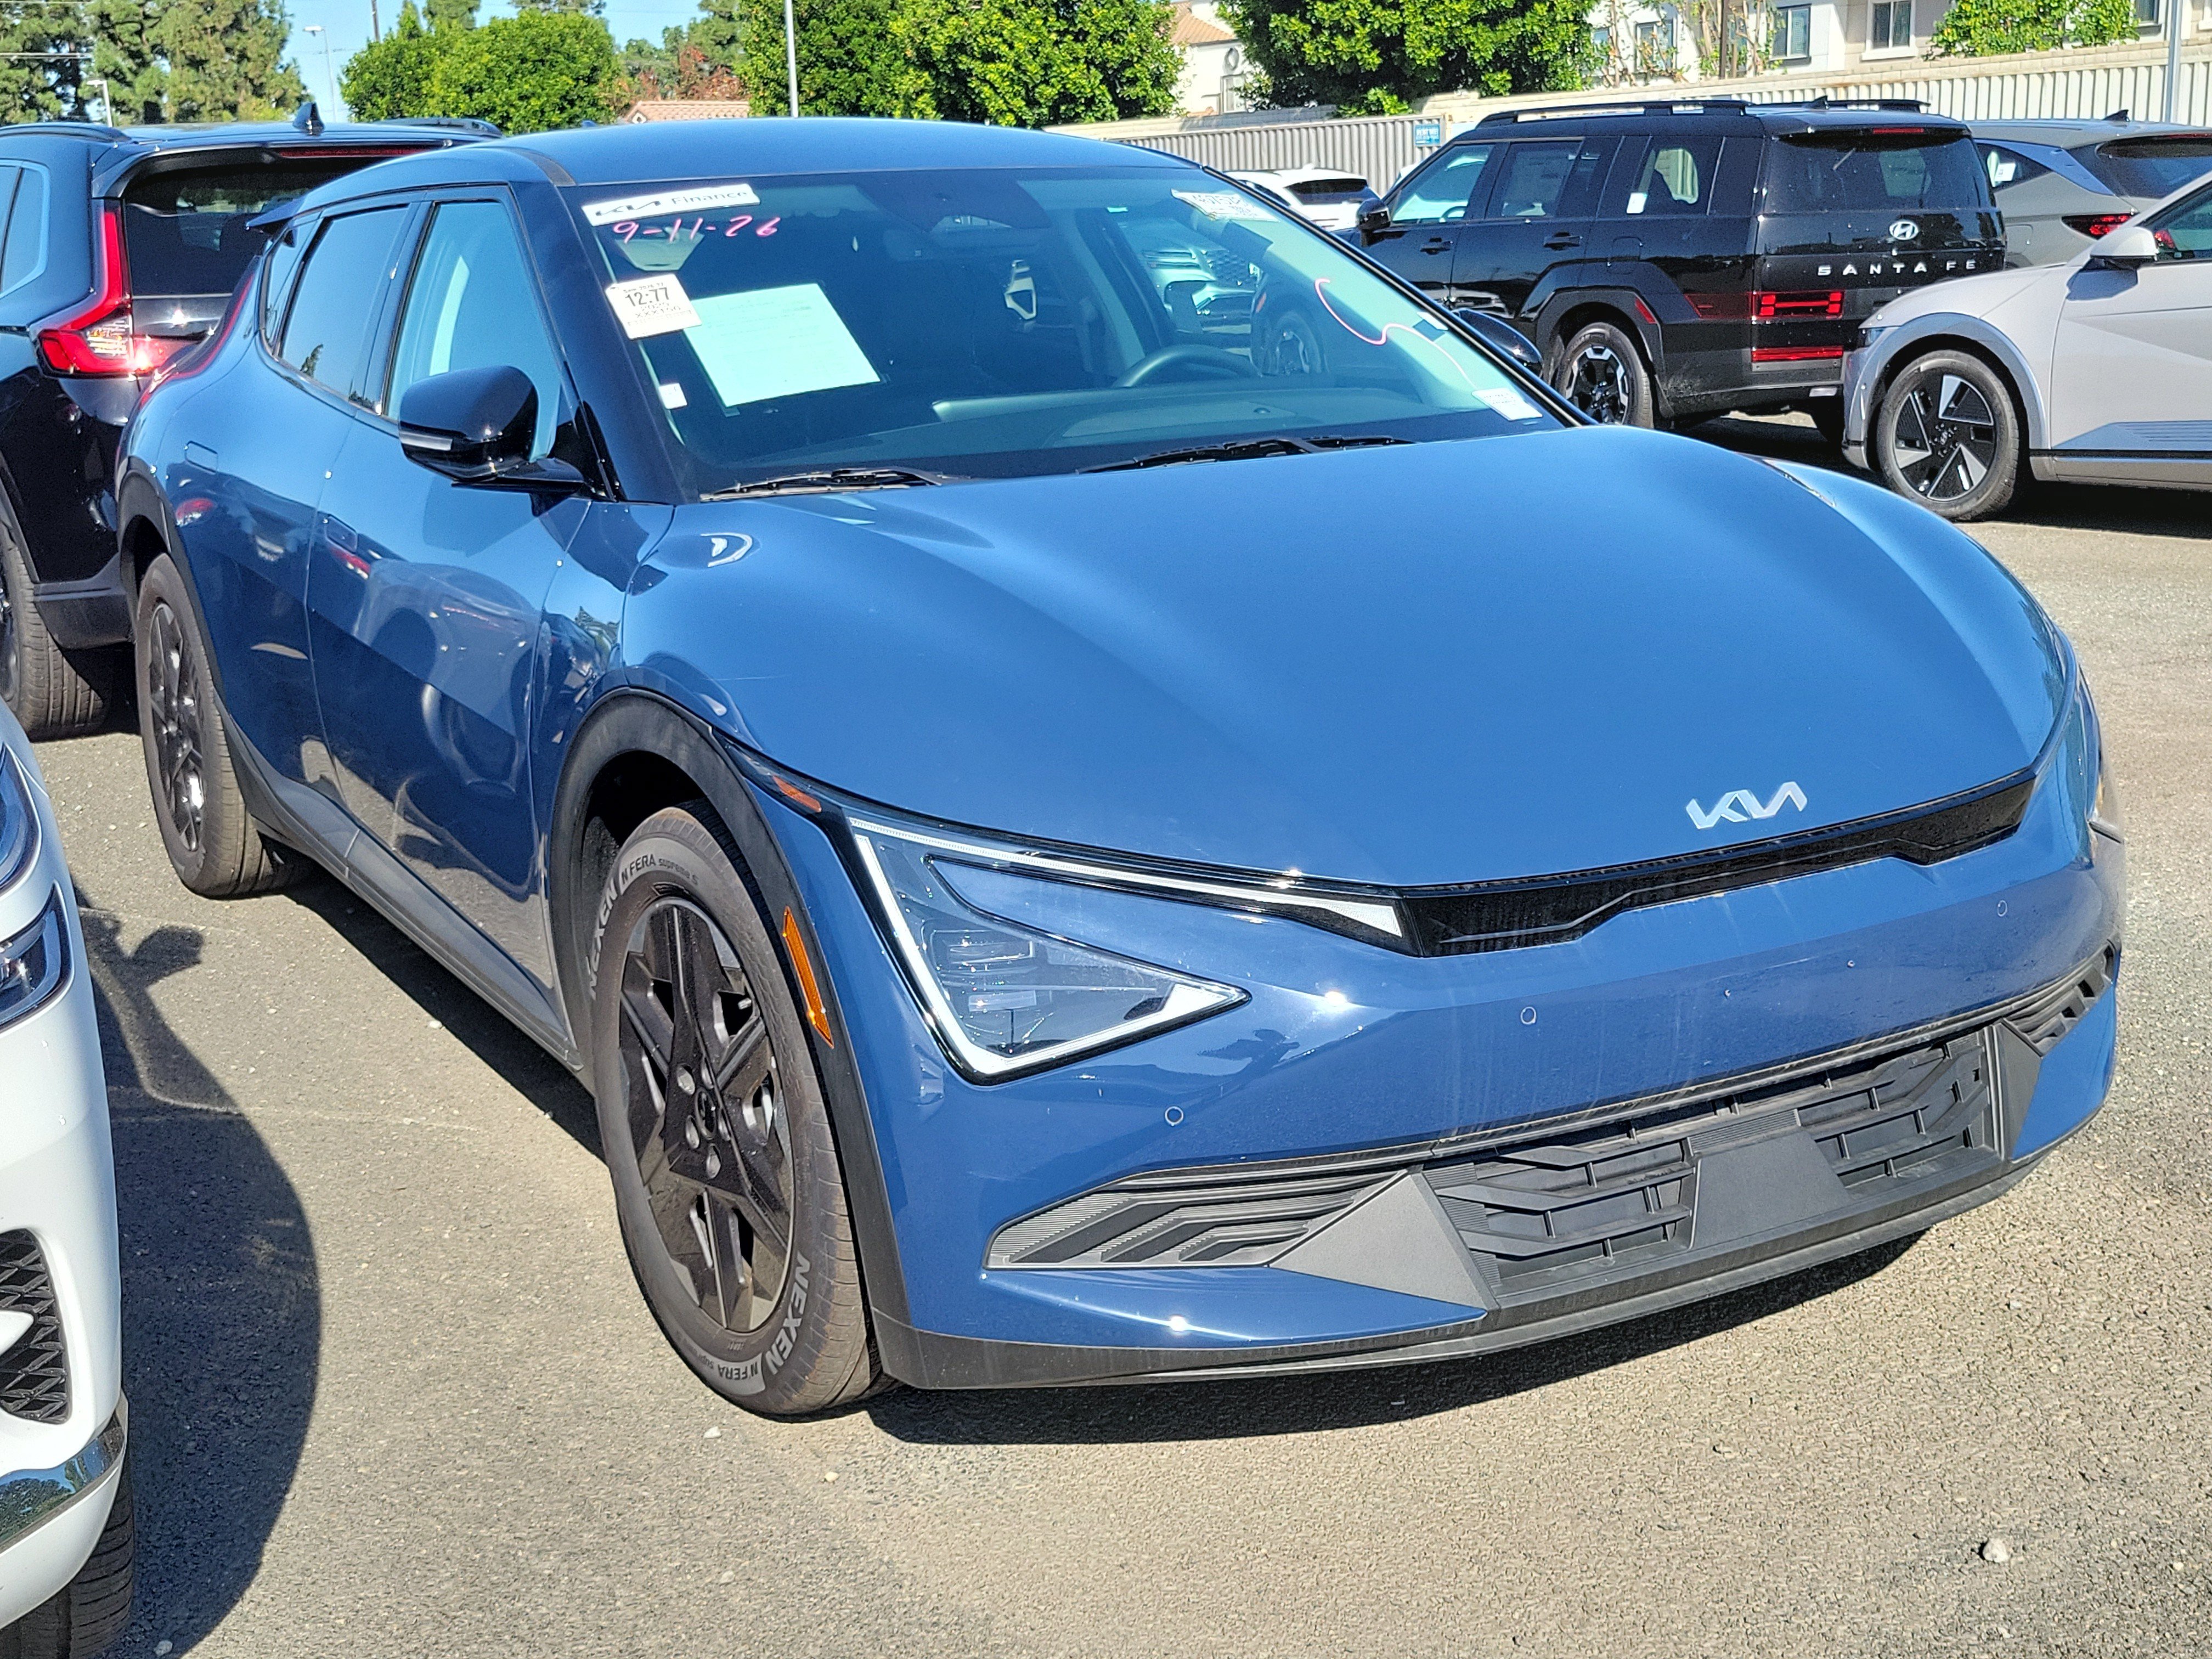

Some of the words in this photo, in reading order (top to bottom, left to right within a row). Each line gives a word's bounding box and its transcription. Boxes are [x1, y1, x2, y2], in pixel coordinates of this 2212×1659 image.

[1818, 261, 1927, 275] SANTA
[1946, 259, 1976, 270] FE
[1685, 781, 1808, 830] KIA
[765, 1250, 811, 1375] NEXEN
